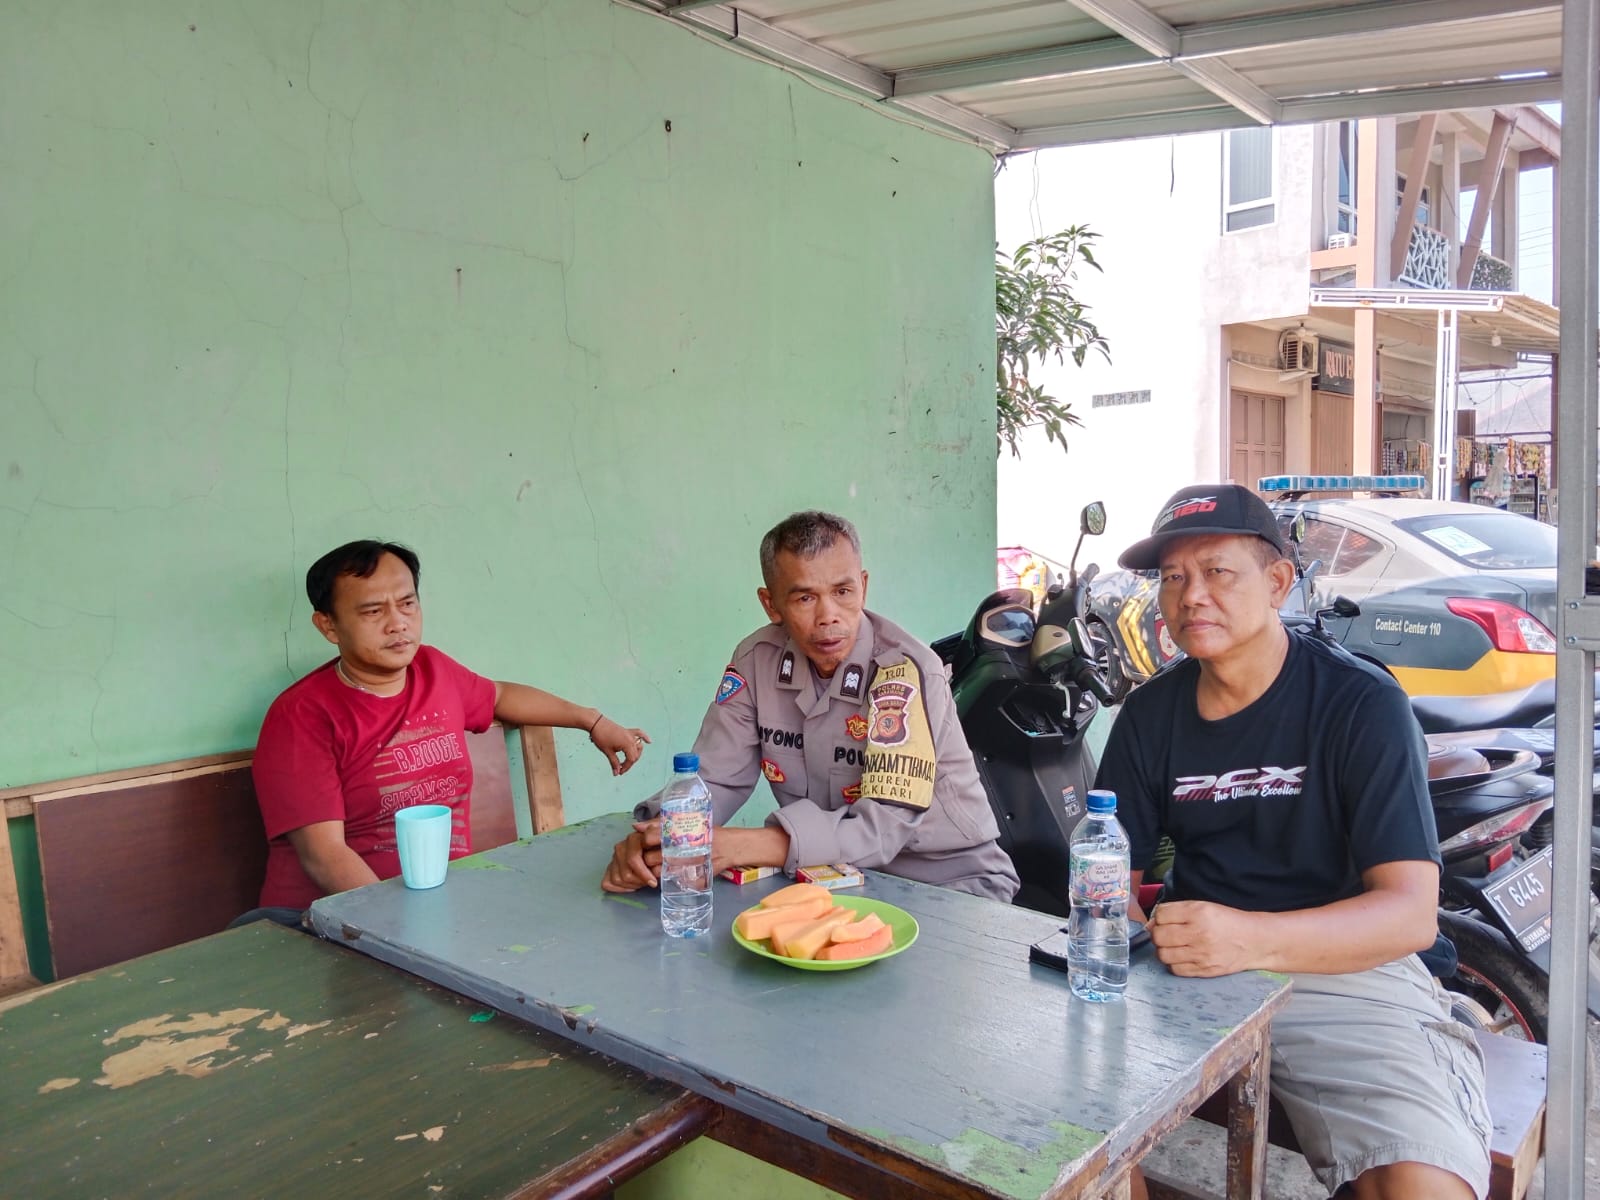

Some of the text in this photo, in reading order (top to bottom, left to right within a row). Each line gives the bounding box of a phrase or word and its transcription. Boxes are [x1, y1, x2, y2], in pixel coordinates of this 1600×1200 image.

[1375, 618, 1441, 636] Contact Center 110
[1173, 766, 1307, 796] PCX
[1213, 791, 1228, 802] The
[1494, 872, 1545, 916] T 6445
